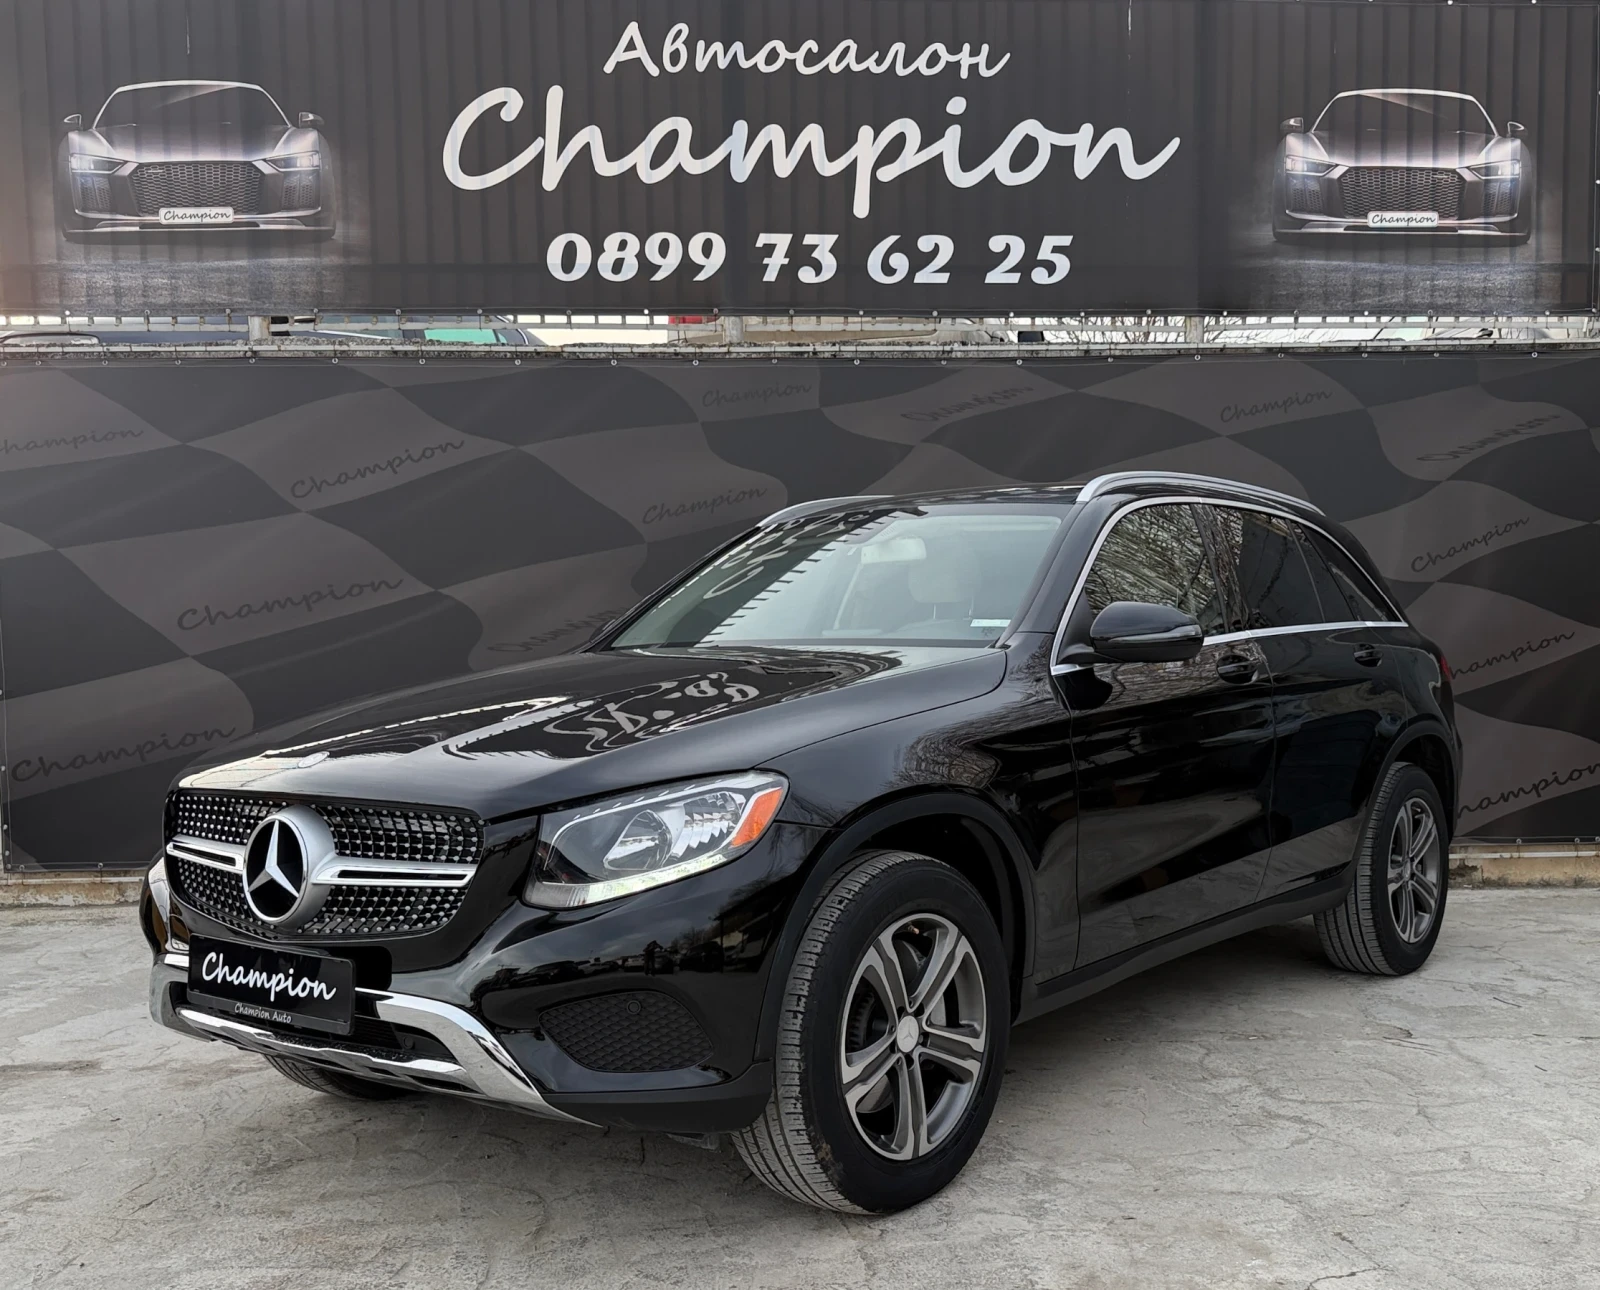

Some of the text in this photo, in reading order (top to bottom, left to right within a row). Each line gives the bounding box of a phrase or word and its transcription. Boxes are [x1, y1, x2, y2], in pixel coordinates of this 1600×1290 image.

[603, 21, 1011, 79] Автосалон
[442, 84, 1181, 219] Champion
[163, 210, 230, 222] Champion
[1371, 213, 1436, 226] Champion
[546, 231, 1075, 285] 0899 73 62 25
[702, 381, 813, 408] Champion
[1220, 388, 1334, 423] Champion
[0, 429, 145, 455] hampion
[290, 439, 465, 500] Champion
[641, 486, 768, 525] Champion
[1410, 515, 1530, 573] Champion
[177, 578, 403, 631] Champion
[1449, 631, 1576, 680] hampion
[11, 726, 236, 782] Champion
[202, 951, 337, 1002] Champion
[234, 1002, 292, 1024] Champion Auto
